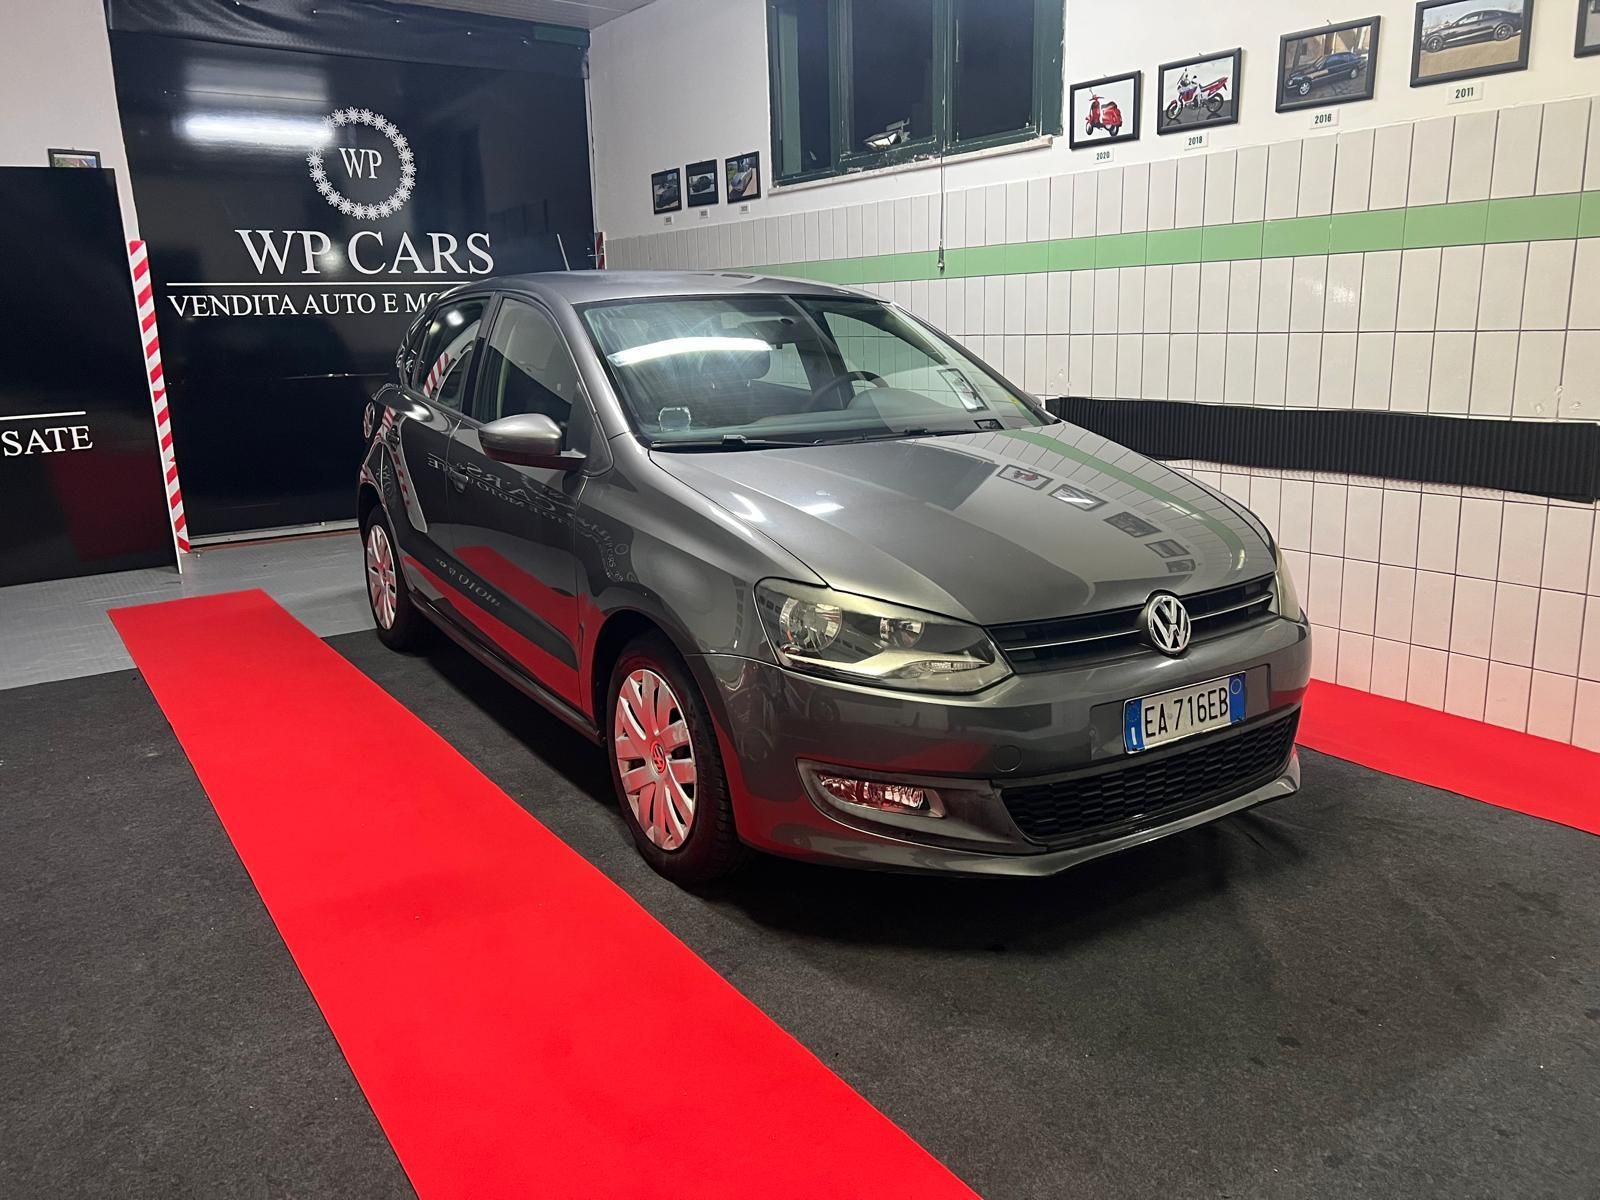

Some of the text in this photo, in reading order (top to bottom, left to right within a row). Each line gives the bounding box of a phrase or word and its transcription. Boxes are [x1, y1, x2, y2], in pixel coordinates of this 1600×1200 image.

[1455, 86, 1474, 99] 2011
[338, 147, 382, 179] WP
[234, 229, 494, 275] WP CARS
[167, 294, 299, 318] VENDITA
[302, 293, 376, 315] AUTO
[382, 293, 399, 313] E
[1, 425, 93, 457] SATE
